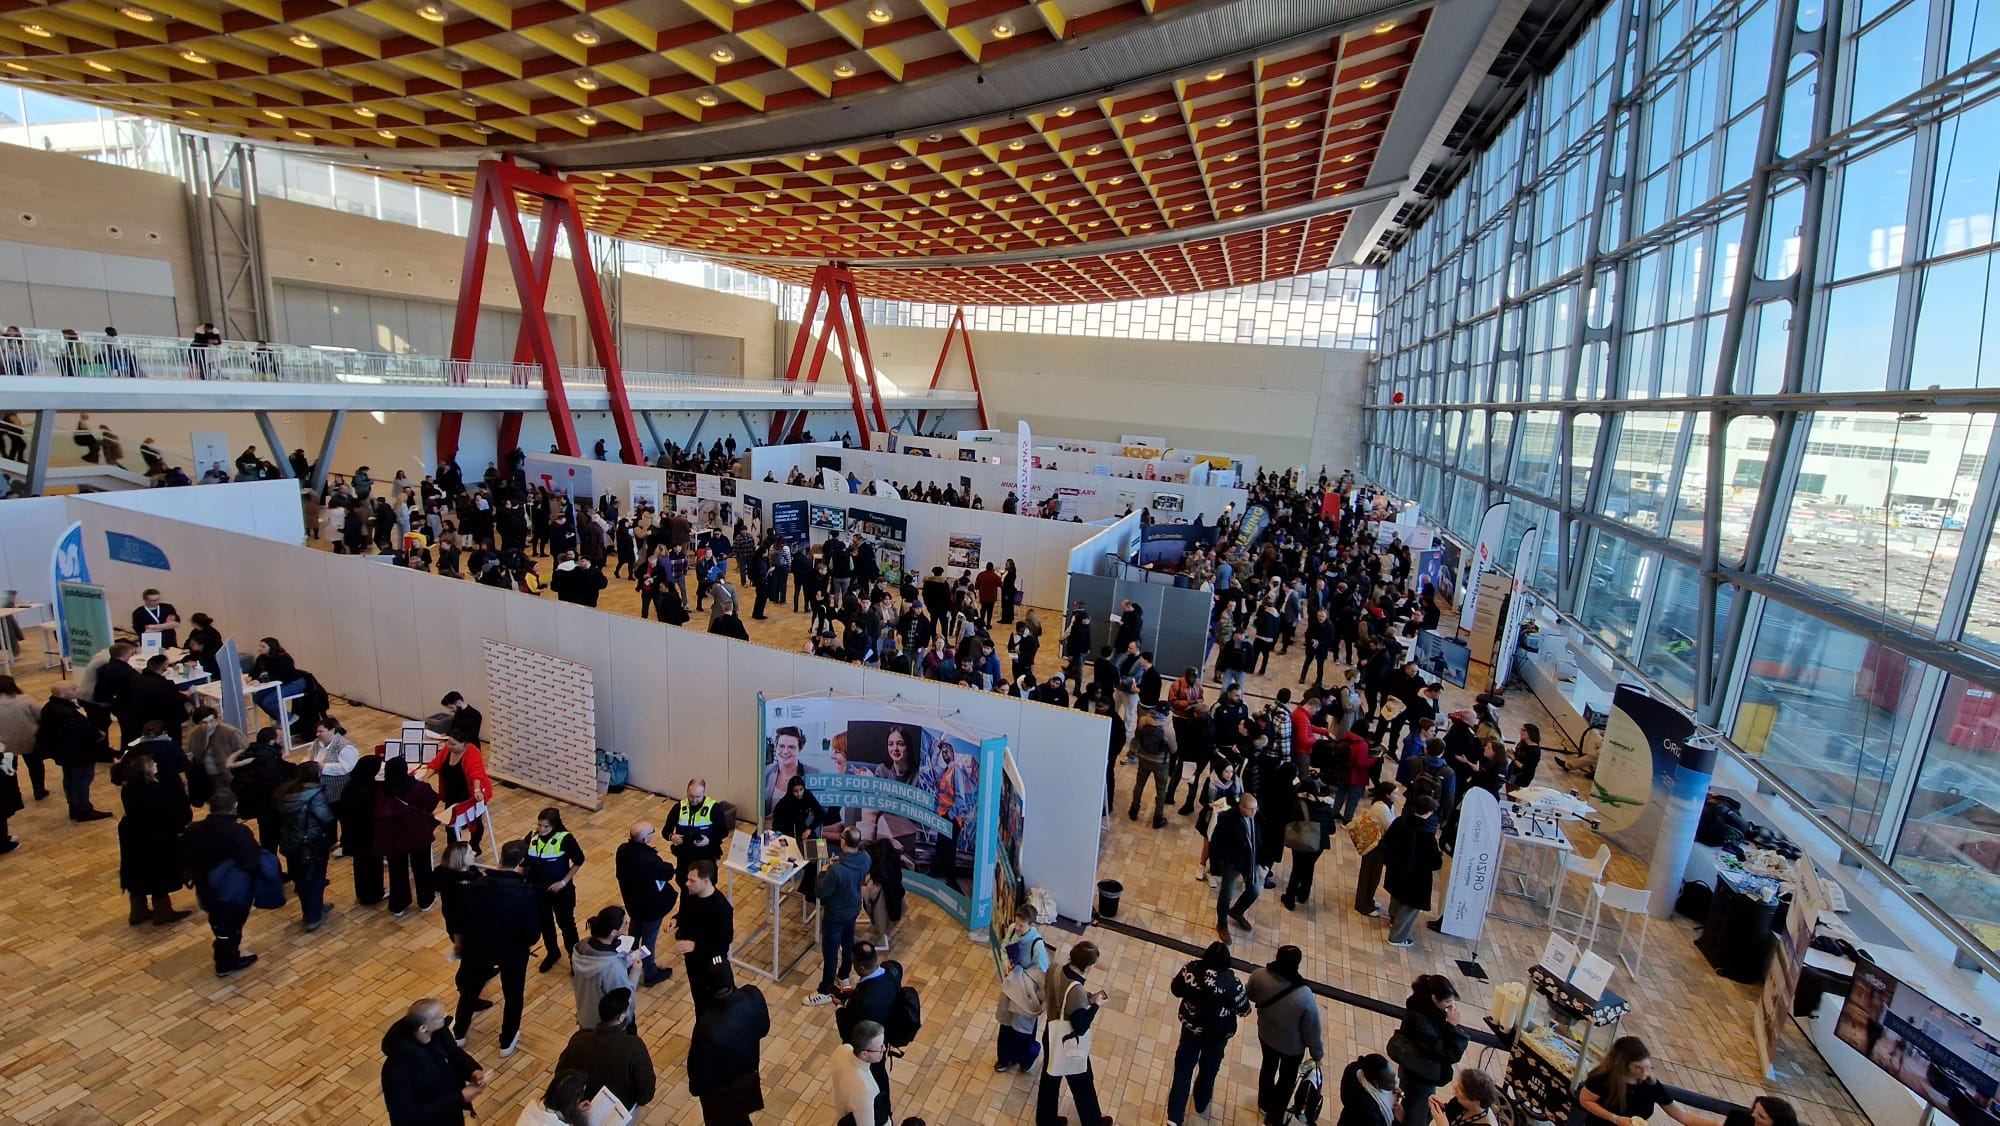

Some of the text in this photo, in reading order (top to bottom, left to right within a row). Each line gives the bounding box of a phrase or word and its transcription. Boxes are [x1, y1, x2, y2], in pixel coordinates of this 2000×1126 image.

[1470, 560, 1485, 609] swissport
[809, 776, 933, 807] DIT IS FOD FINANCIËN.
[844, 795, 859, 808] ÇA
[862, 796, 875, 807] LE
[878, 798, 898, 811] SPF
[900, 803, 950, 834] FINANCES.
